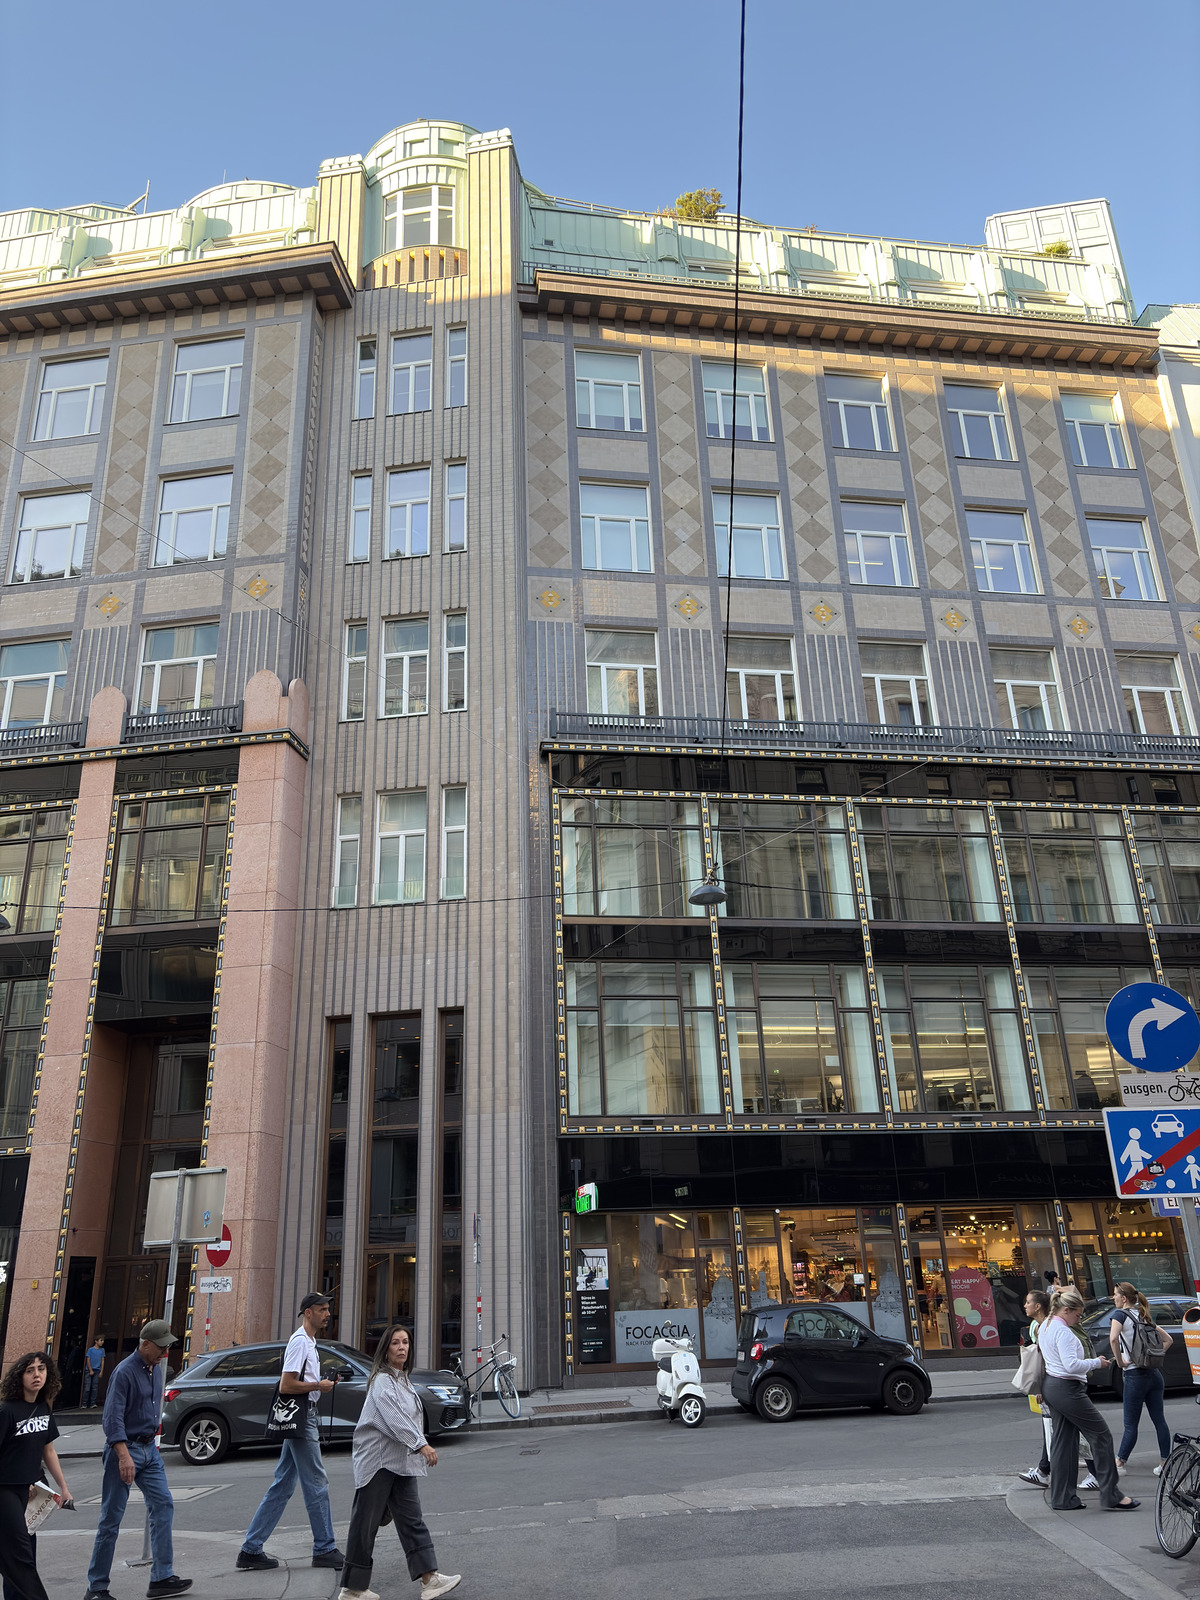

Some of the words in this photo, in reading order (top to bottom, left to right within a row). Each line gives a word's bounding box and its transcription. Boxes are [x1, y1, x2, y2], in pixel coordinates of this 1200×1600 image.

[1122, 1084, 1167, 1097] ausgen.
[625, 1324, 690, 1340] FOCACCIA
[27, 1493, 54, 1527] EGWEAR
